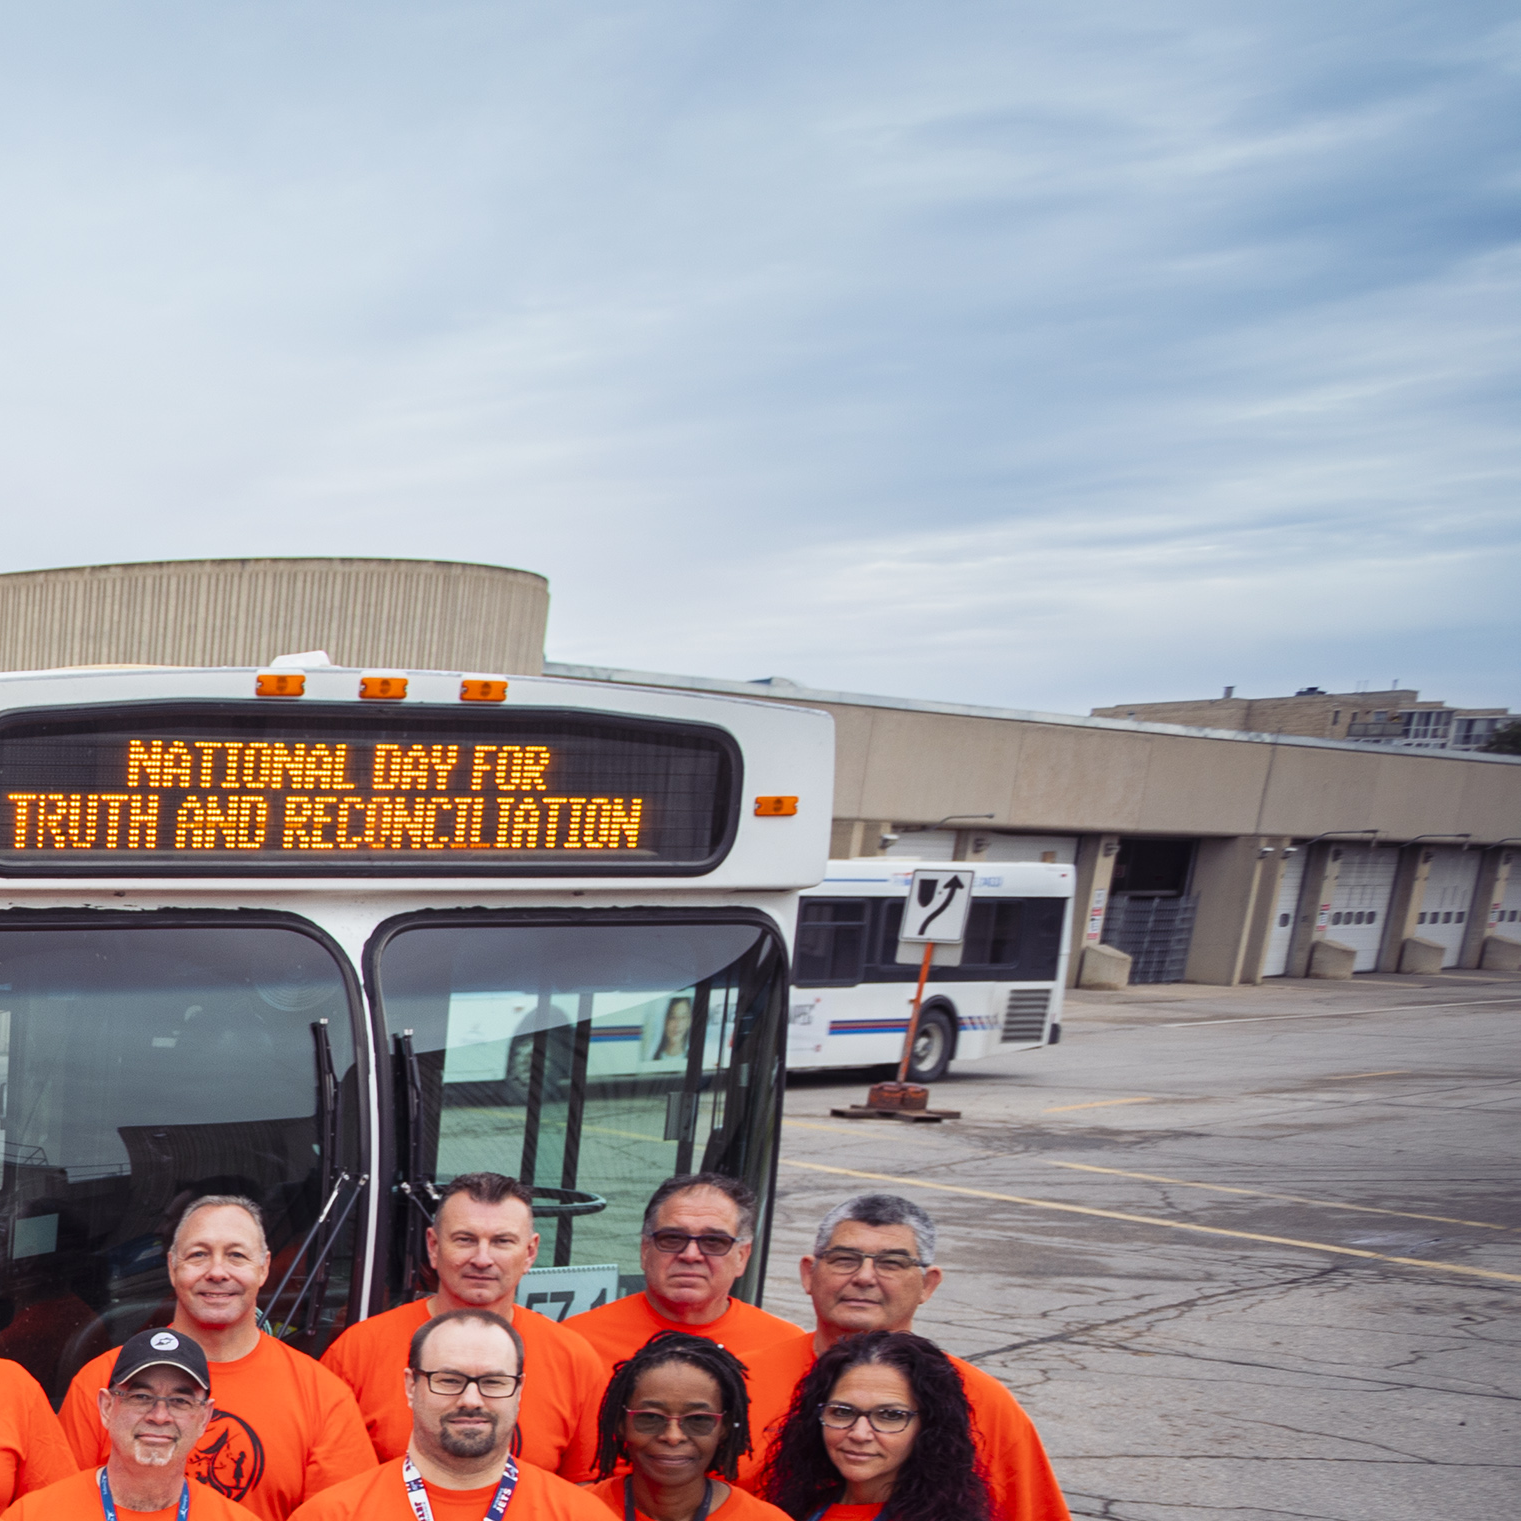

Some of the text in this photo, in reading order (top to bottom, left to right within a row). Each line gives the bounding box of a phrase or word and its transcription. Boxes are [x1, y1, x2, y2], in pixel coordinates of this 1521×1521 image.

[127, 739, 551, 791] NATIONAL DAY FOR
[8, 793, 643, 850] TRUTH AND RECONCILIATION
[496, 1488, 512, 1514] JETS
